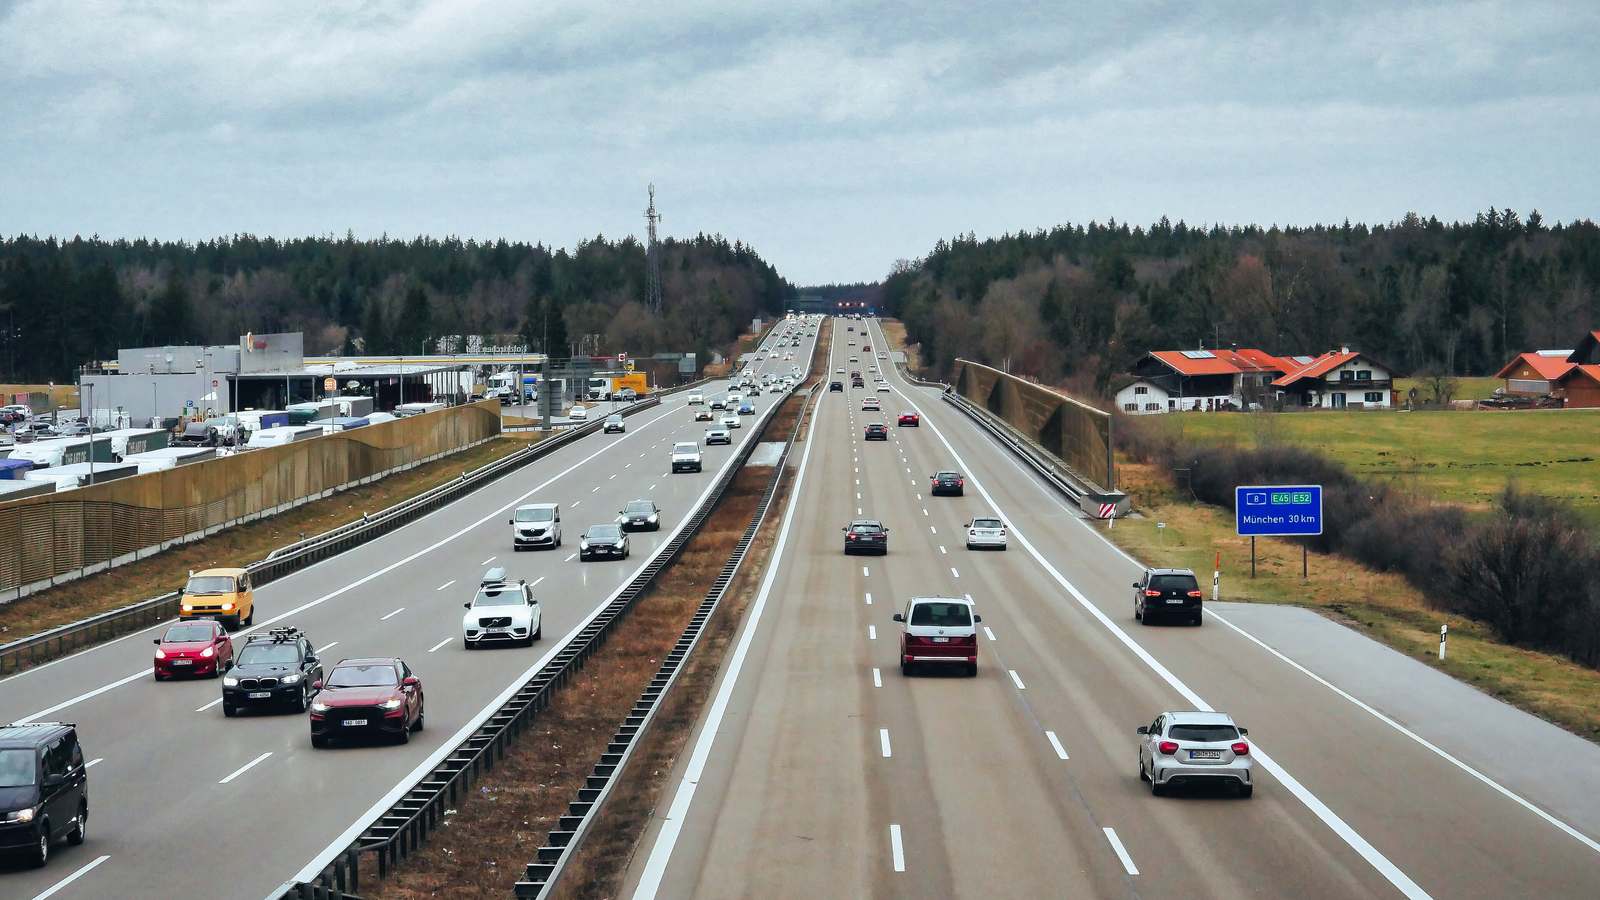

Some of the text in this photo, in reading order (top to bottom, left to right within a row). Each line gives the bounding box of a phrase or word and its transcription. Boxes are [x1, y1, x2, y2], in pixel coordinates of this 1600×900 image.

[1273, 494, 1289, 502] E45
[1293, 494, 1310, 502] E52
[1243, 514, 1315, 523] München 30 km
